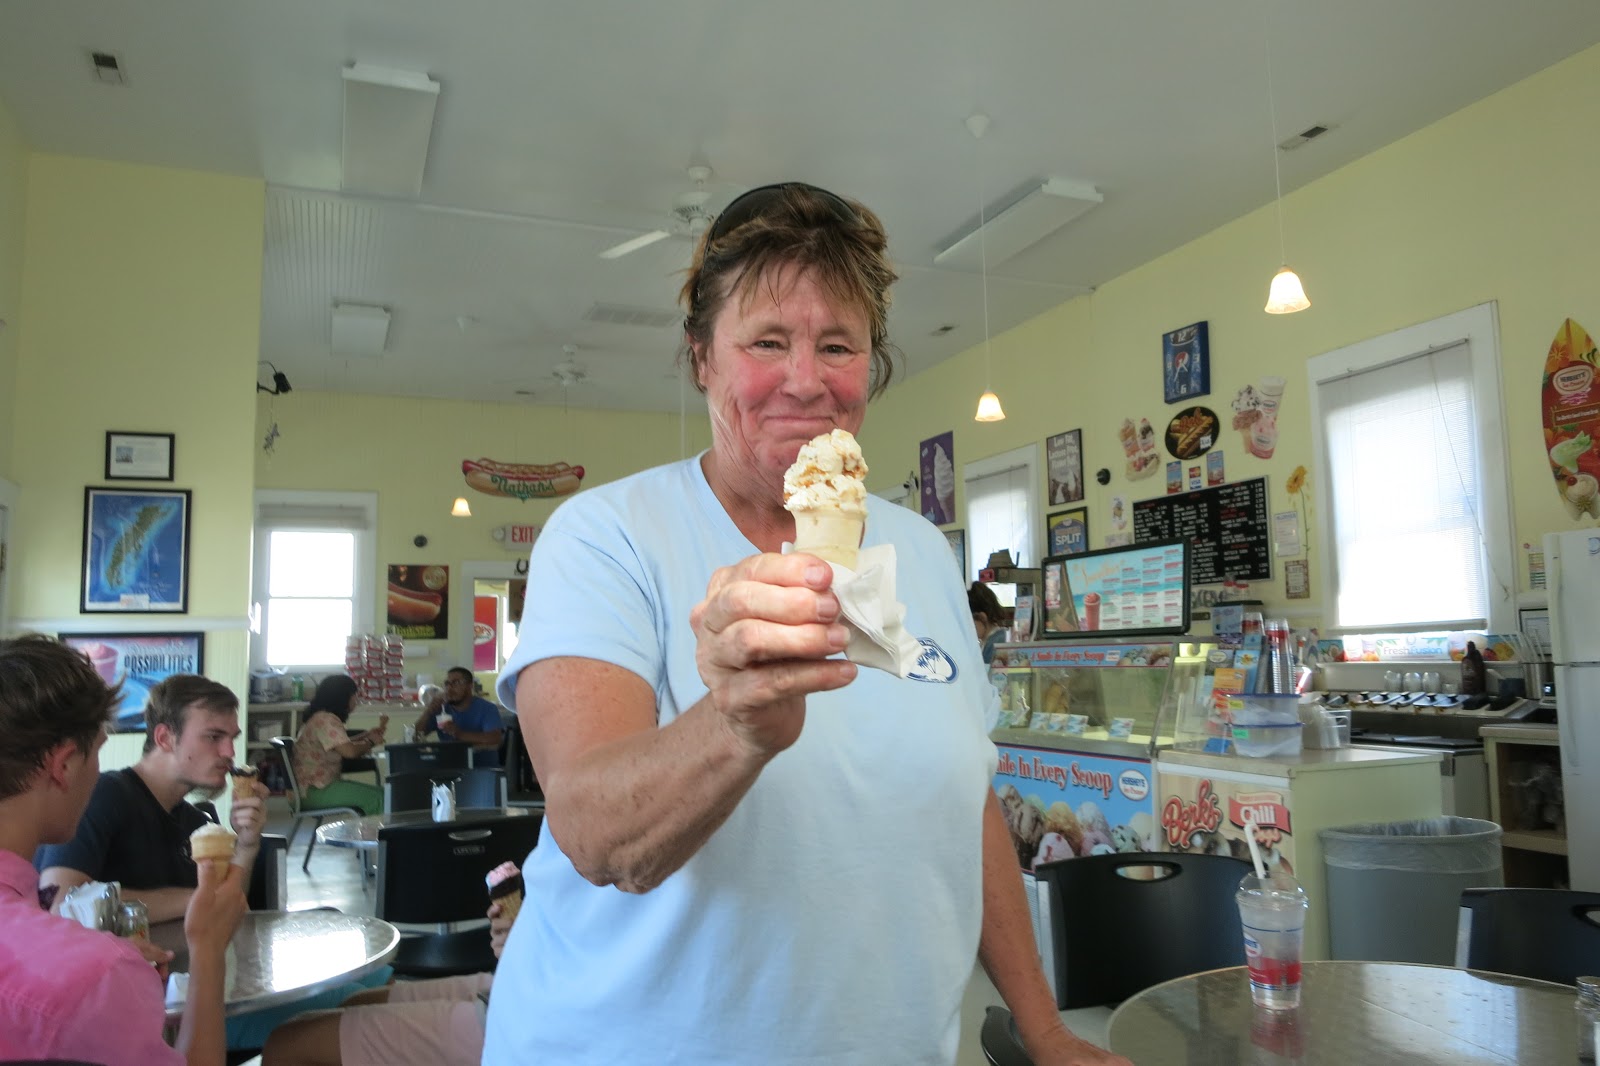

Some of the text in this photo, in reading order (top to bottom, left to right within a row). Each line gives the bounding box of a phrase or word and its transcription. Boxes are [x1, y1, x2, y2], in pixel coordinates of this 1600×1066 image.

[511, 526, 535, 543] EXIT
[1056, 533, 1081, 545] SPLIT
[1018, 755, 1031, 776] In
[1032, 756, 1068, 790] Every
[1071, 762, 1112, 798] Scoop
